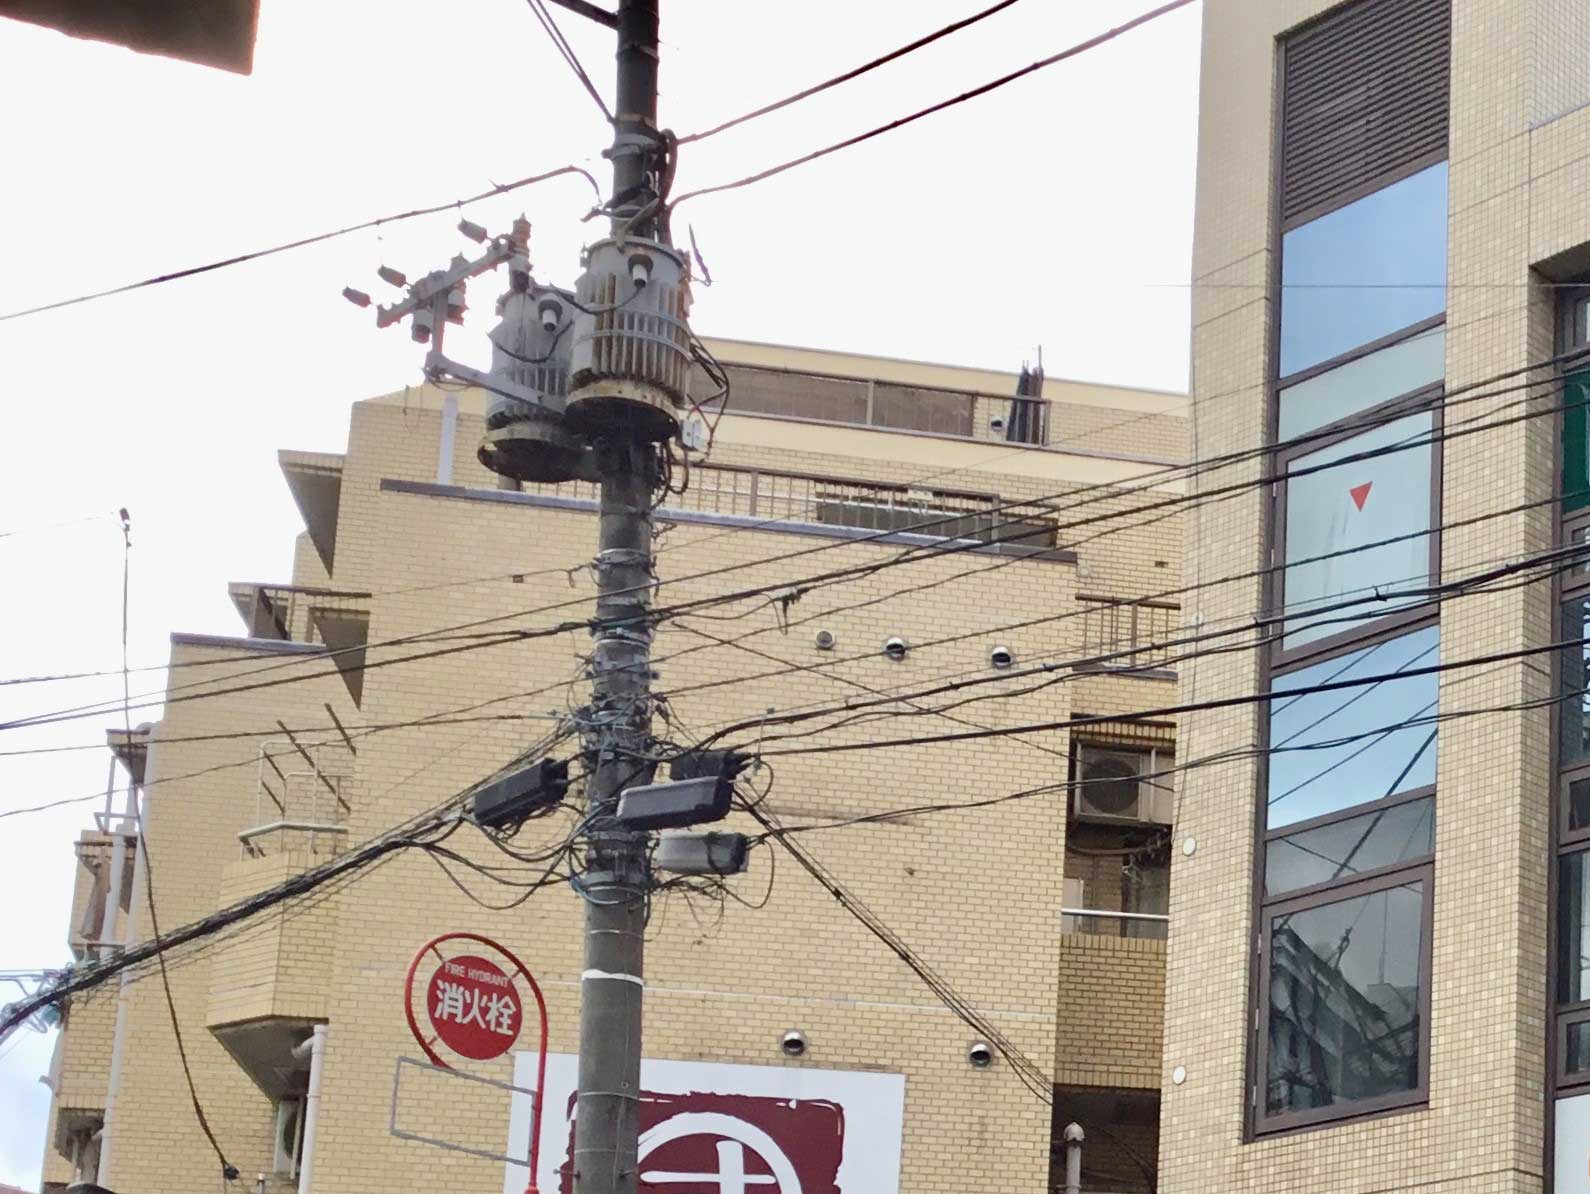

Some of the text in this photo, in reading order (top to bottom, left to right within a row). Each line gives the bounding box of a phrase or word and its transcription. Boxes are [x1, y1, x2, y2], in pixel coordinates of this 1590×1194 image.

[445, 962, 509, 988] FIRE HYDRANT
[434, 979, 517, 1036] 消火栓
